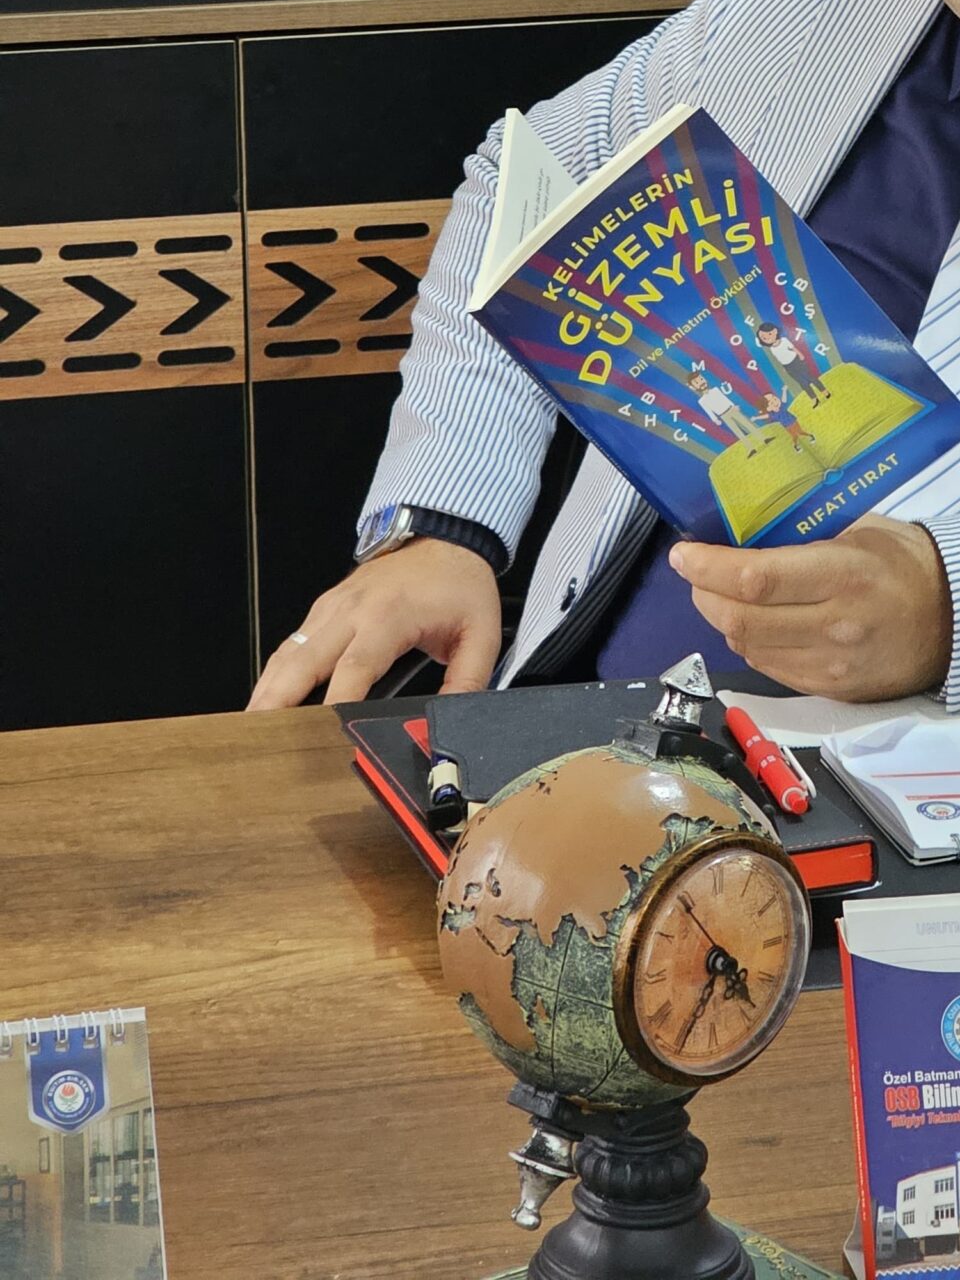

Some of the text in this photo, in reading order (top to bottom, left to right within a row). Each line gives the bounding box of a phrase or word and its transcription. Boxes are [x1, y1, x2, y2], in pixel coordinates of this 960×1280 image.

[542, 168, 695, 303] KELİMELERİN
[559, 179, 738, 346] GİZEMLİ
[774, 272, 788, 286] C
[793, 277, 809, 292] B
[578, 216, 774, 387] DÜNYASI
[804, 303, 816, 320] Ş
[628, 264, 763, 379] Dil ve Anlatım Öyküleri
[729, 333, 743, 347] O
[793, 327, 807, 342] T
[814, 342, 830, 357] R
[690, 359, 707, 373] M
[746, 359, 759, 372] P
[720, 381, 734, 396] Ü
[640, 391, 656, 406] B
[618, 403, 633, 417] A
[670, 408, 682, 423] T
[644, 413, 657, 428] H
[796, 452, 899, 535] RIFAT FIRAT
[883, 1070, 912, 1086] Özel
[884, 1085, 921, 1113] OSB
